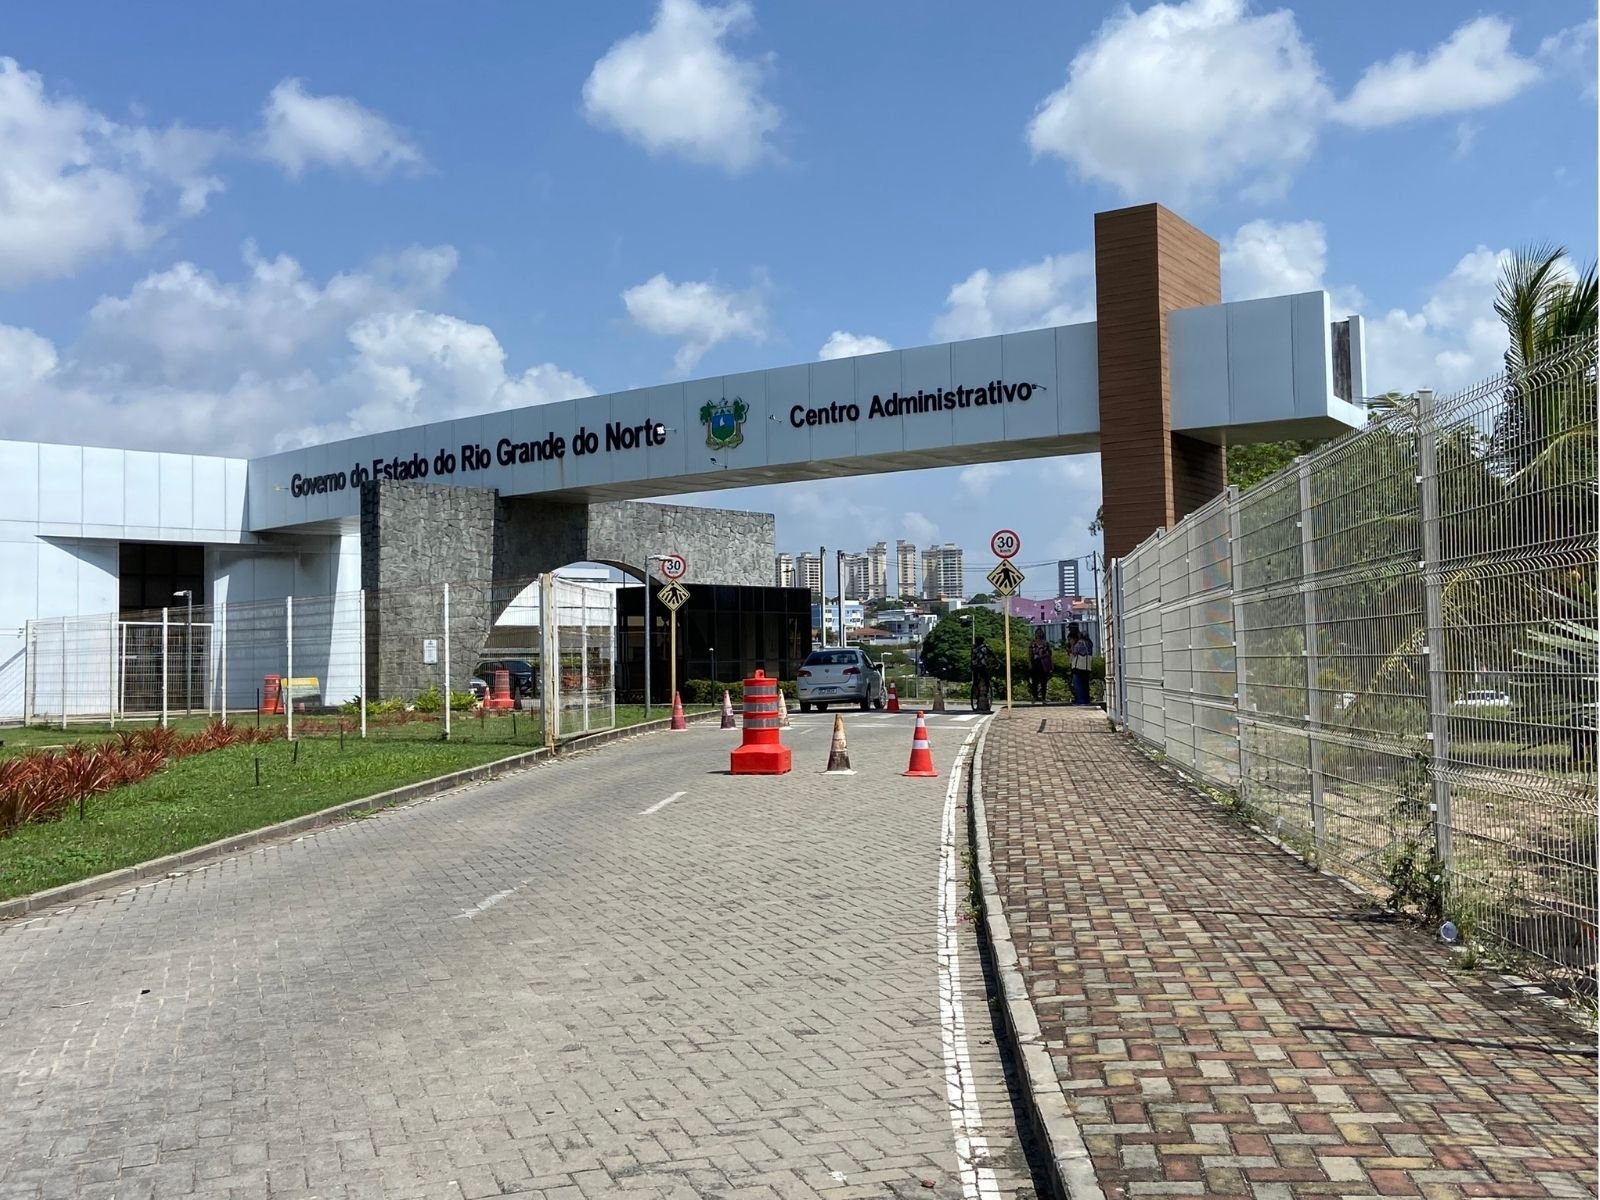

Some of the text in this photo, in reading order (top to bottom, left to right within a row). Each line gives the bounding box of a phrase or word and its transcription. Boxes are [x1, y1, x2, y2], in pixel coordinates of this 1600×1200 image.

[790, 380, 1032, 428] Centro Administrativo
[291, 418, 666, 498] Governo do Estado do Rio Grande do Norte
[997, 536, 1014, 548] 30
[667, 560, 681, 570] 30
